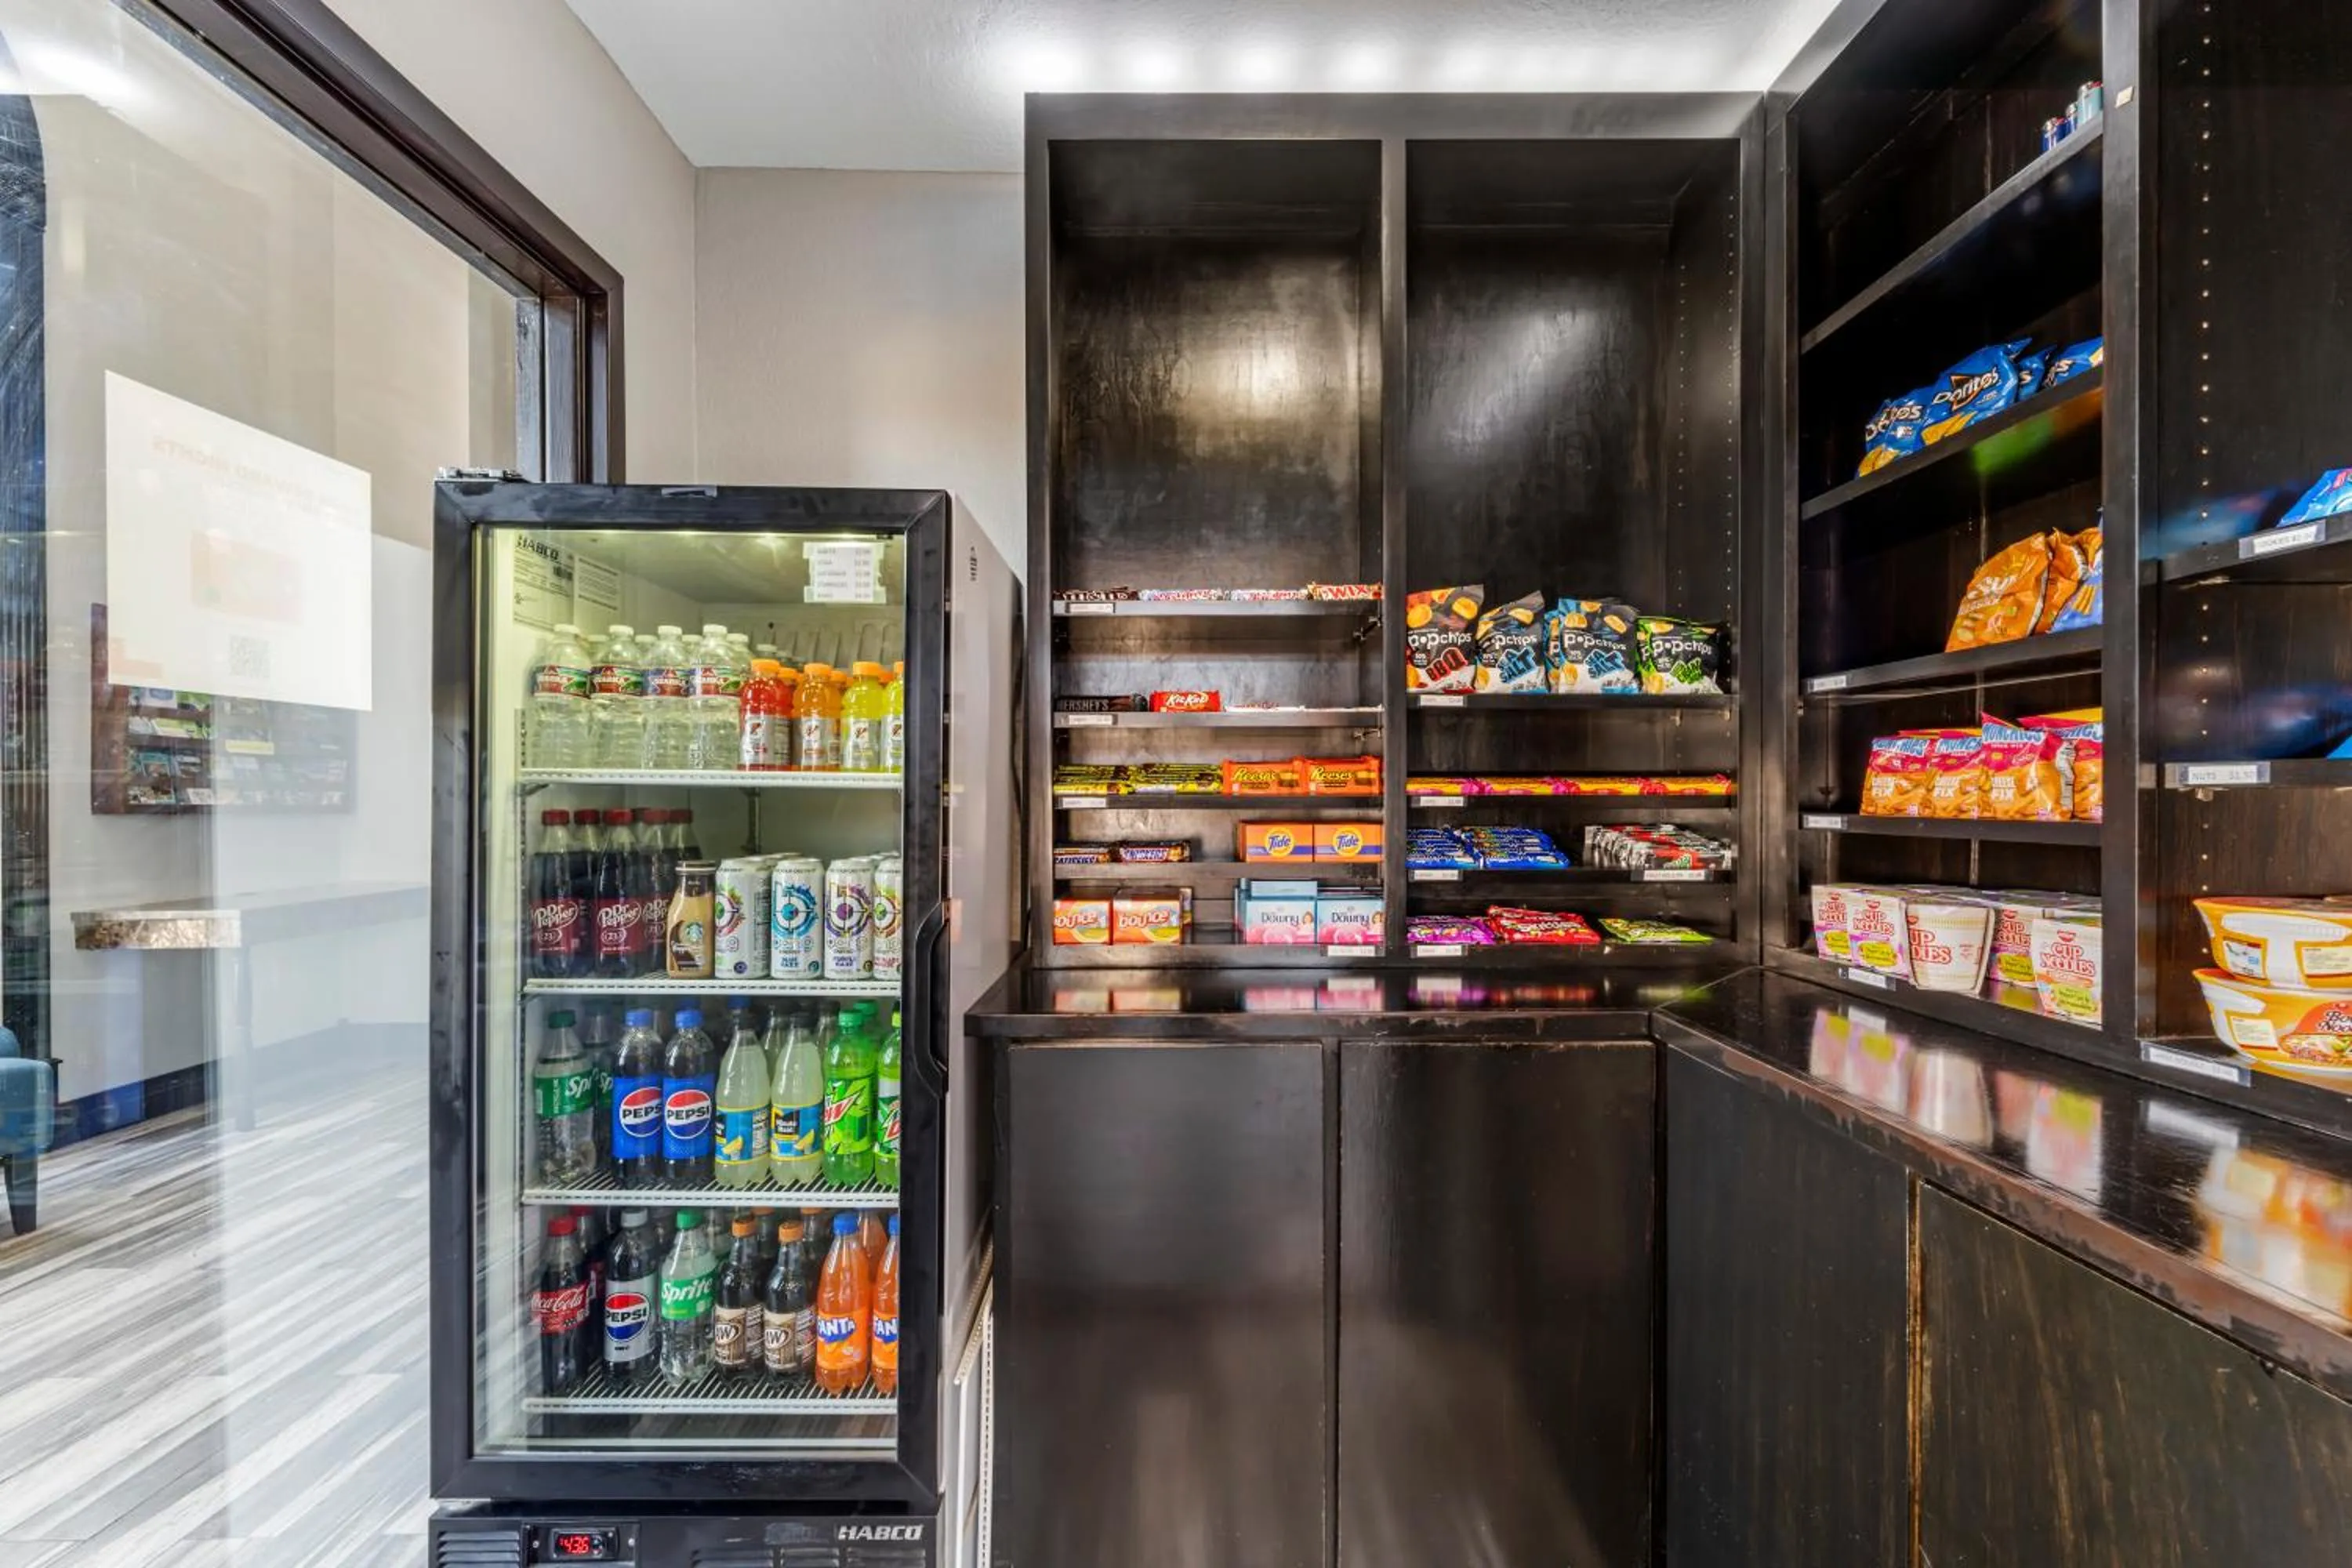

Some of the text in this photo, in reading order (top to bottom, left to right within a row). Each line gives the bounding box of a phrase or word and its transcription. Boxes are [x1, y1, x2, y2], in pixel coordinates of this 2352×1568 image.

[1269, 833, 1291, 850] Tide
[1336, 833, 1359, 850] Tide
[1261, 912, 1299, 926] Downy
[1331, 912, 1370, 926] Downy
[1910, 928, 1936, 946] UP
[2052, 942, 2085, 961] CUP
[2040, 953, 2096, 978] NOODLES
[622, 1105, 662, 1120] PEPS
[667, 1106, 710, 1120] PEPSI
[662, 1276, 713, 1304] Sprite
[838, 1525, 924, 1541] HABCO
